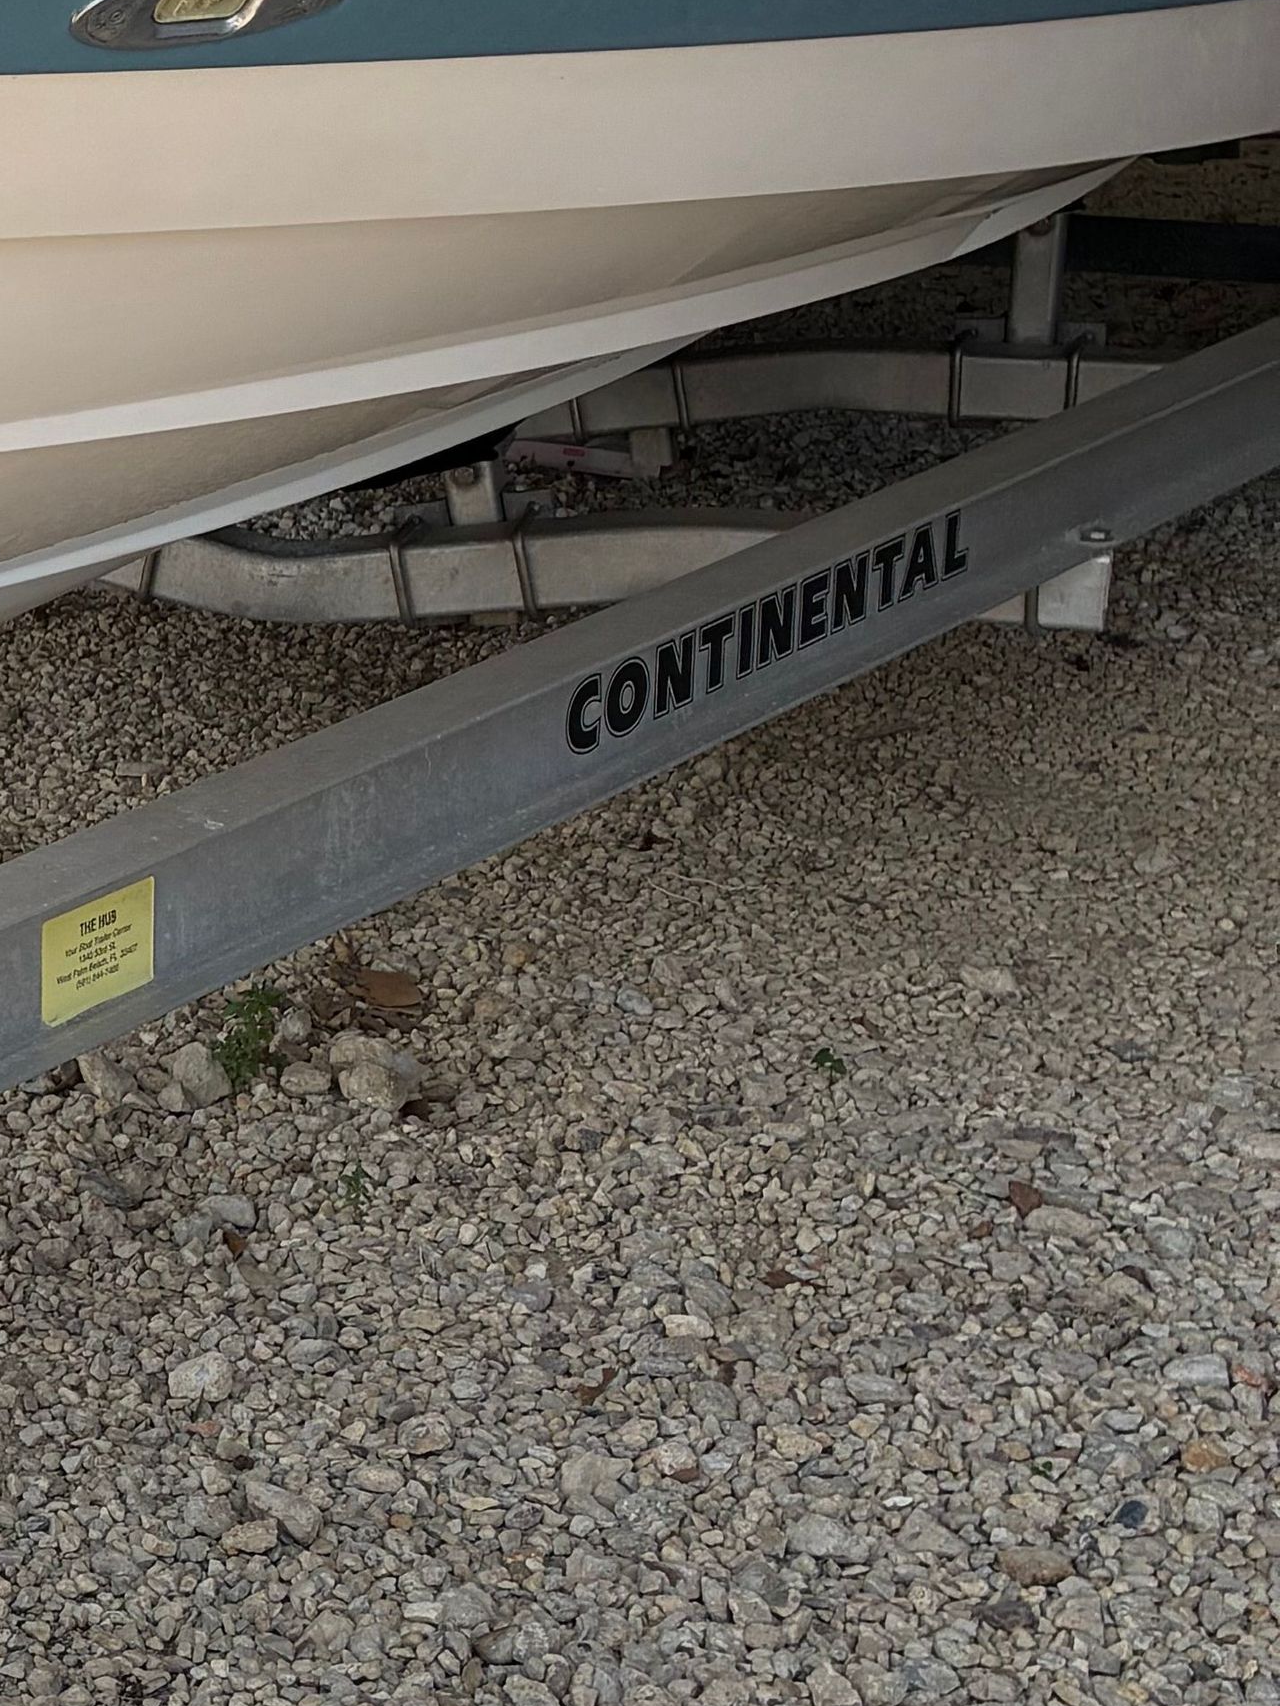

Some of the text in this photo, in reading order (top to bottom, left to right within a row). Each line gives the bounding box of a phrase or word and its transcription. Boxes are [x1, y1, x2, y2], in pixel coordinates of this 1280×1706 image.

[565, 509, 970, 755] CONTINENTAL
[80, 909, 117, 936] THE HUB
